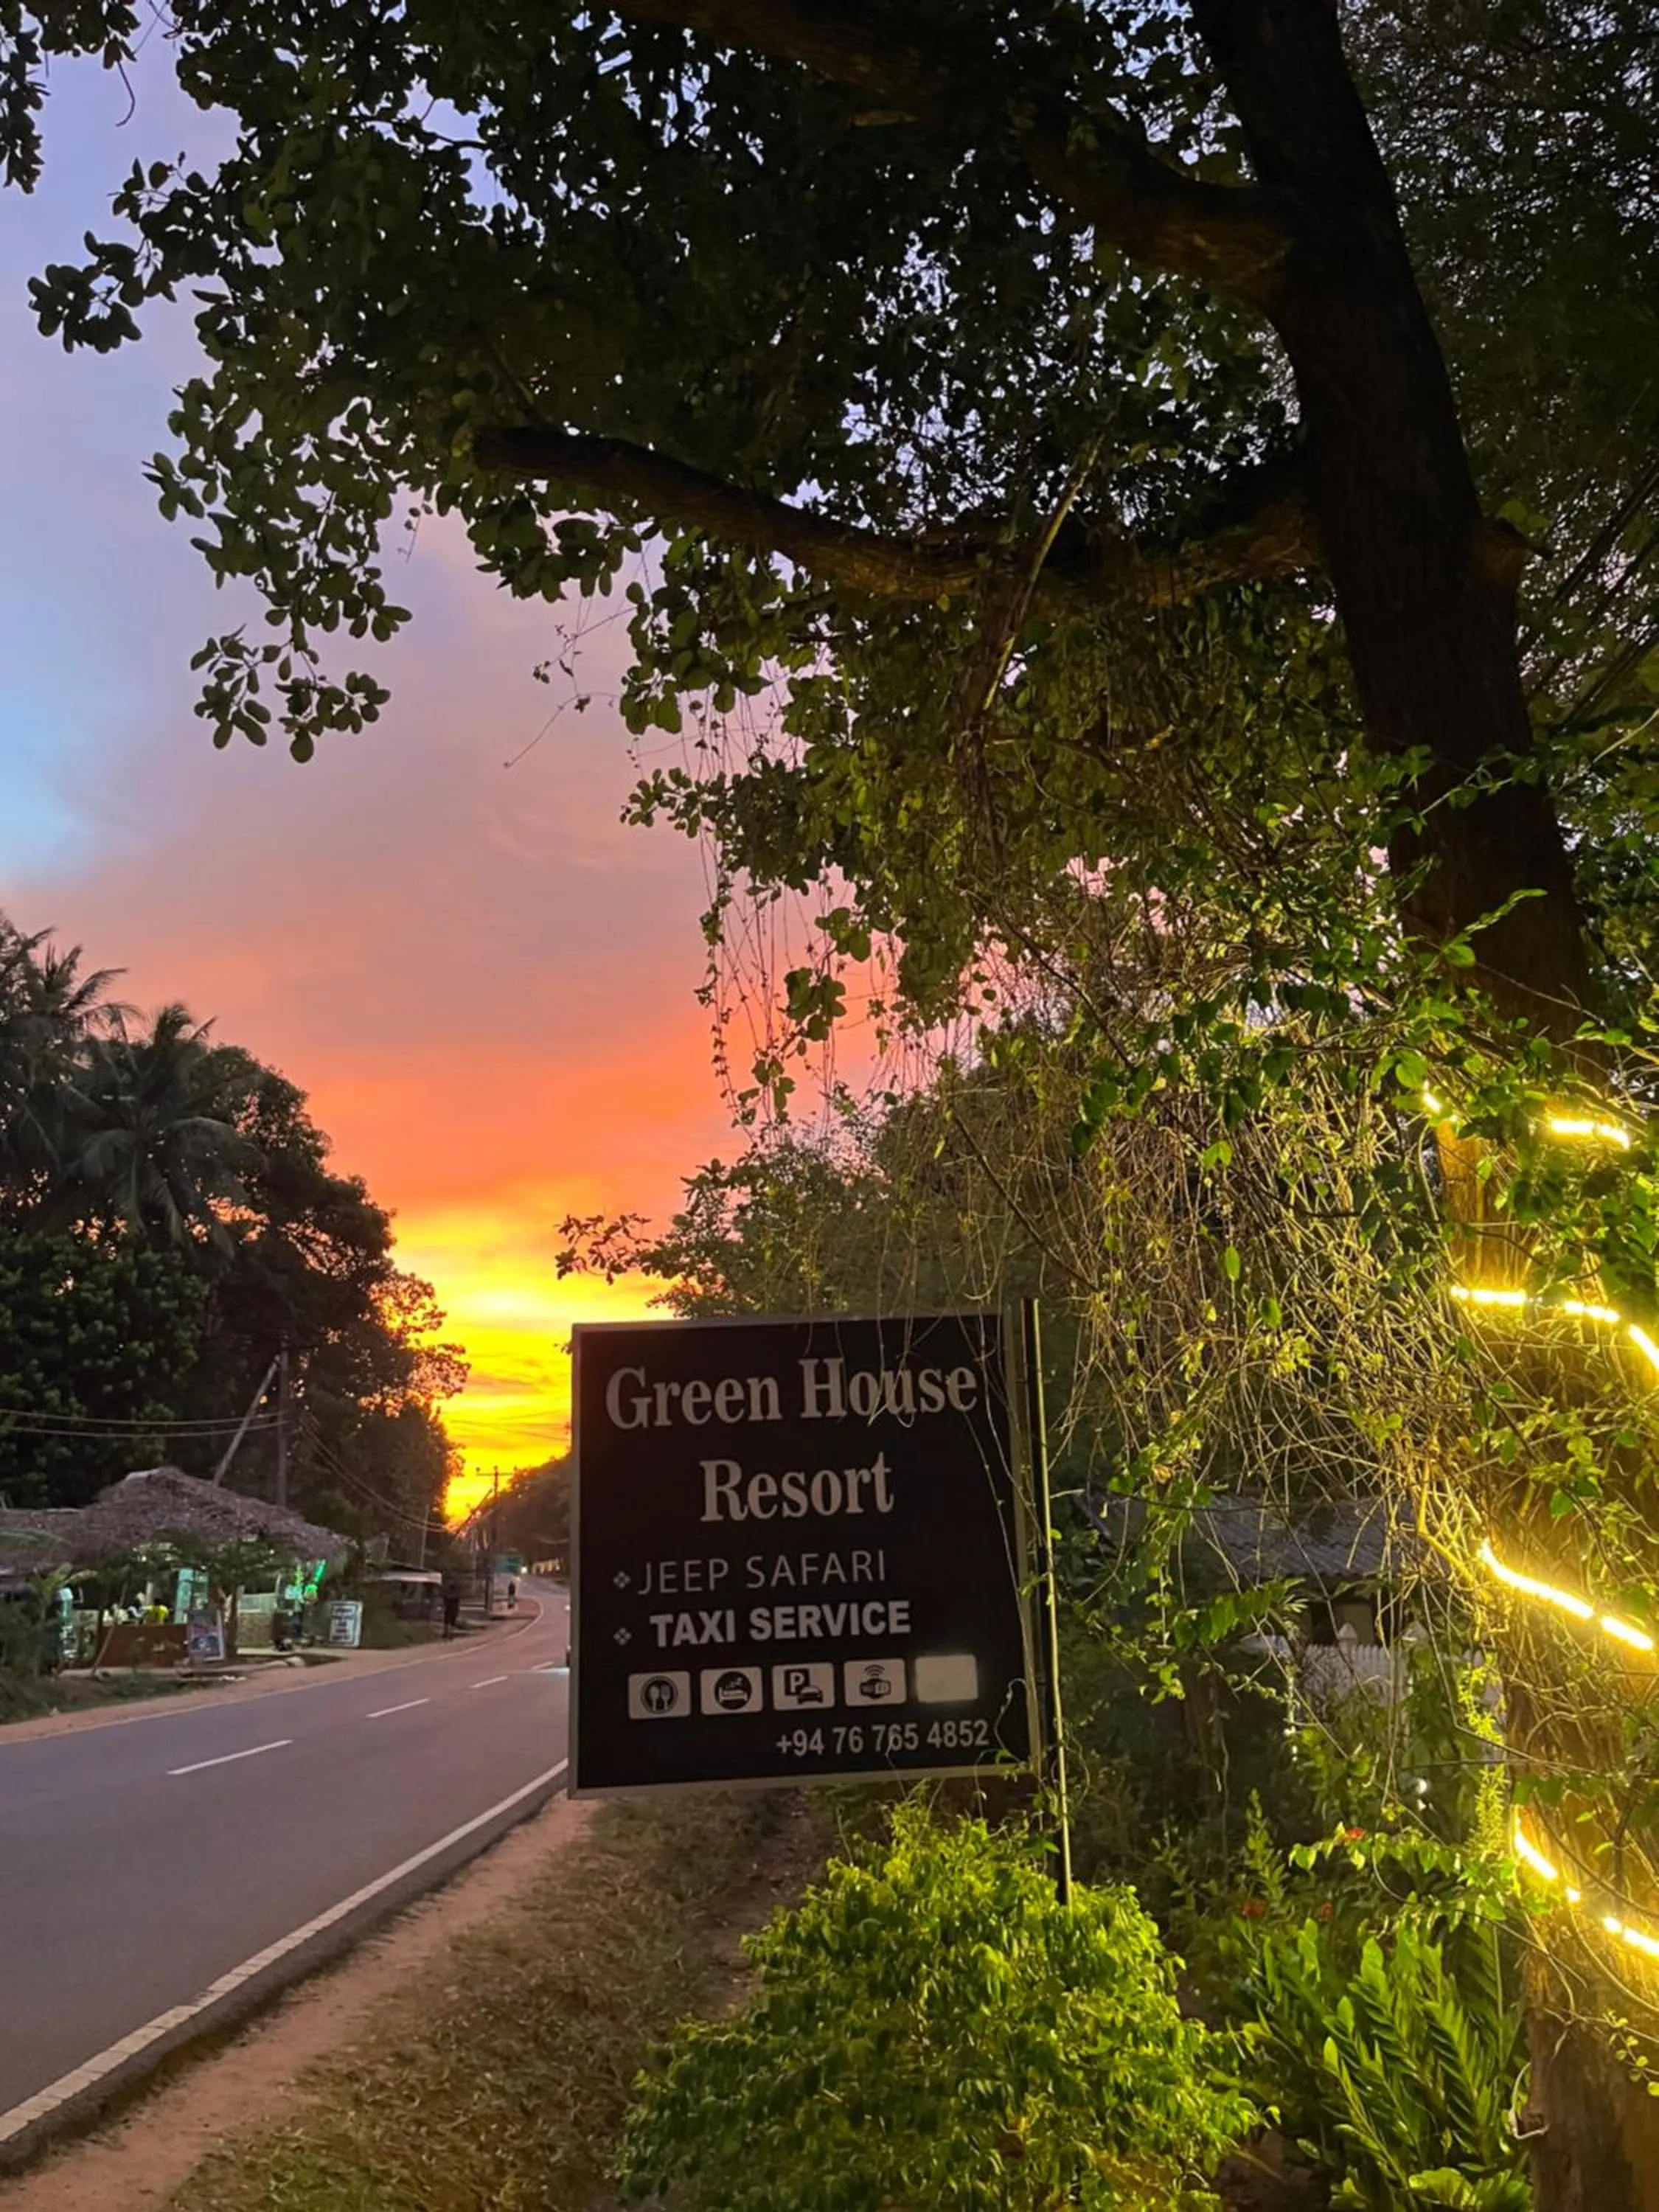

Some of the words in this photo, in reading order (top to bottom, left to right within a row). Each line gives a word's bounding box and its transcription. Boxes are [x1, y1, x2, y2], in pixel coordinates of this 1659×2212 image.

[606, 1367, 782, 1429] Green
[799, 1357, 978, 1419] House
[700, 1452, 894, 1522] Resort
[638, 1558, 728, 1595] JEEP
[746, 1549, 885, 1588] SAFARI
[650, 1610, 735, 1647] TAXI
[750, 1601, 911, 1640] SERVICE
[790, 1672, 804, 1694] P
[776, 1728, 824, 1756] +94
[832, 1726, 863, 1754] 76
[872, 1723, 919, 1752] 765
[927, 1719, 990, 1749] 4852
